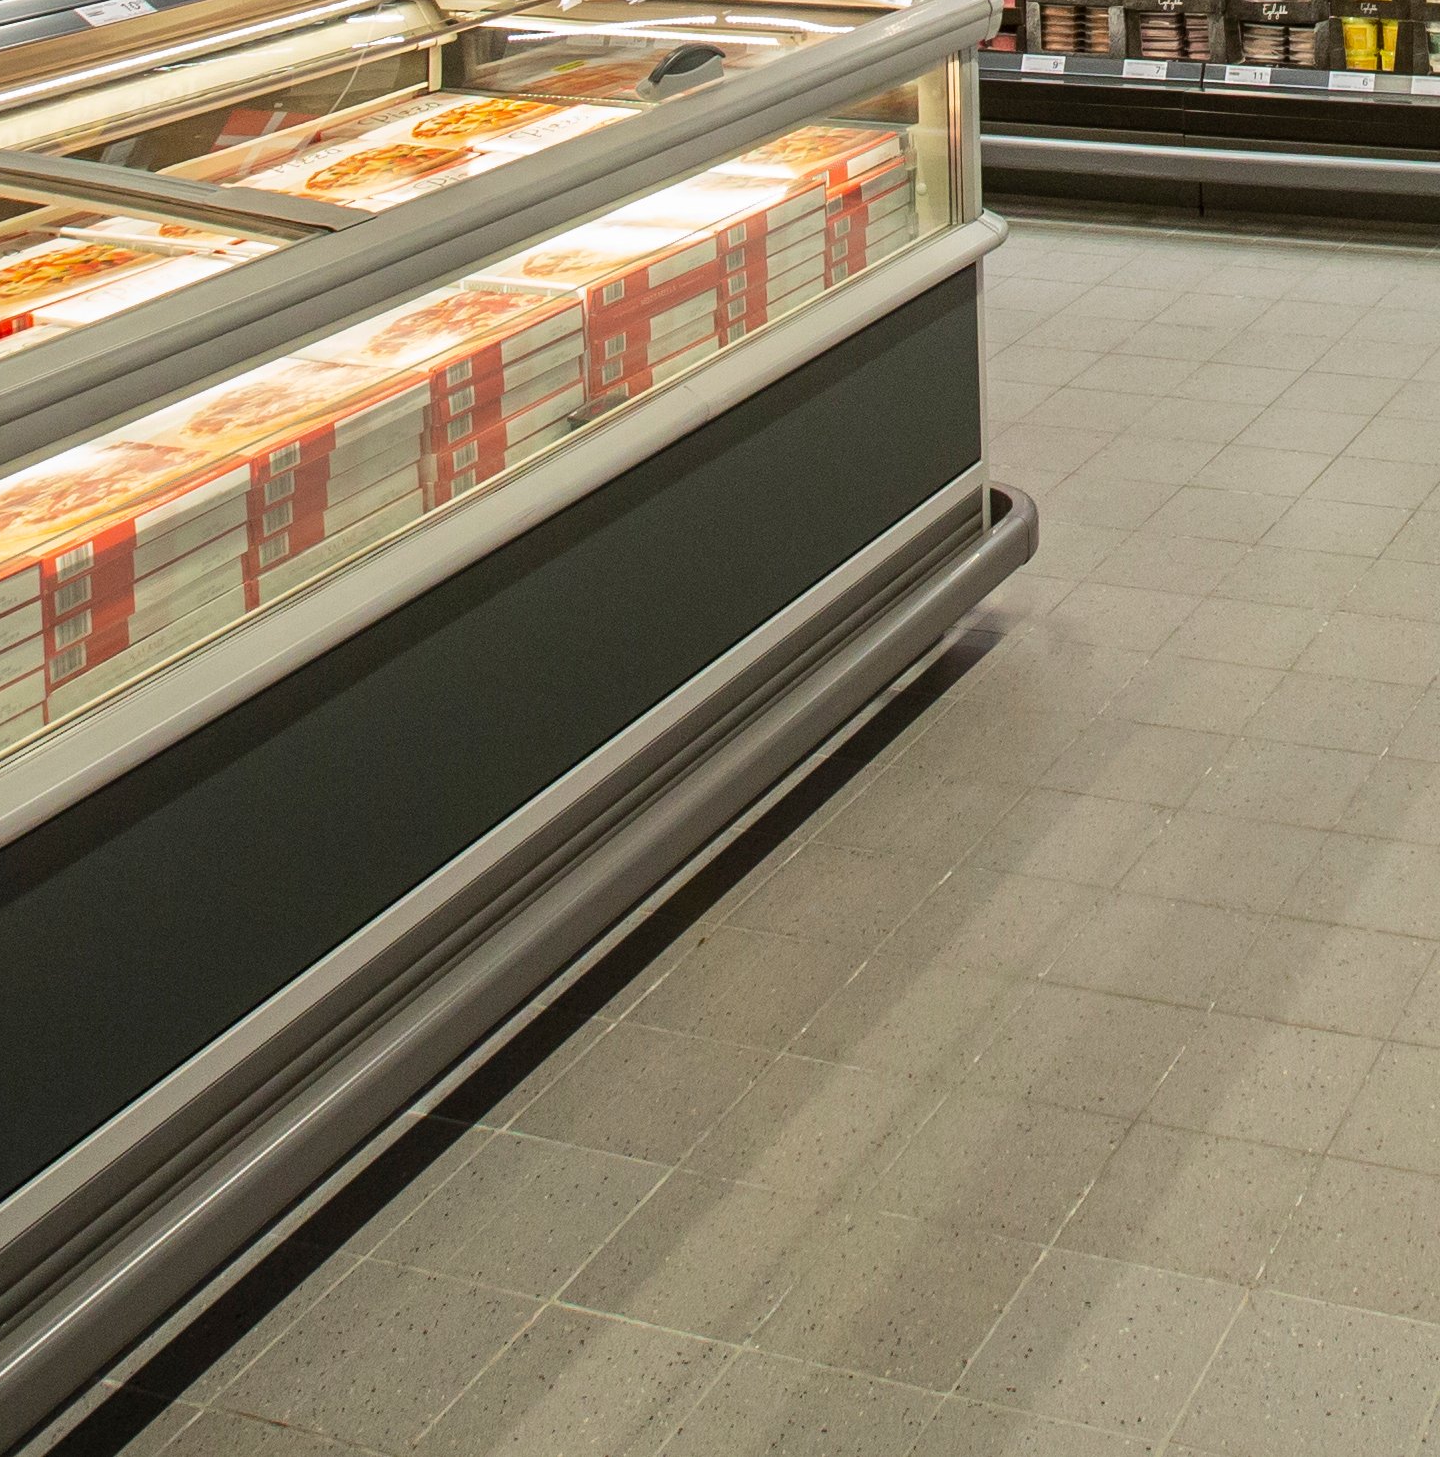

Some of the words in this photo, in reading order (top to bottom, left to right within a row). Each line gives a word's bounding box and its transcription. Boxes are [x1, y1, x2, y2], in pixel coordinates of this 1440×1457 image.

[120, 0, 142, 14] 10
[1053, 60, 1058, 69] 9
[1252, 72, 1264, 80] 11
